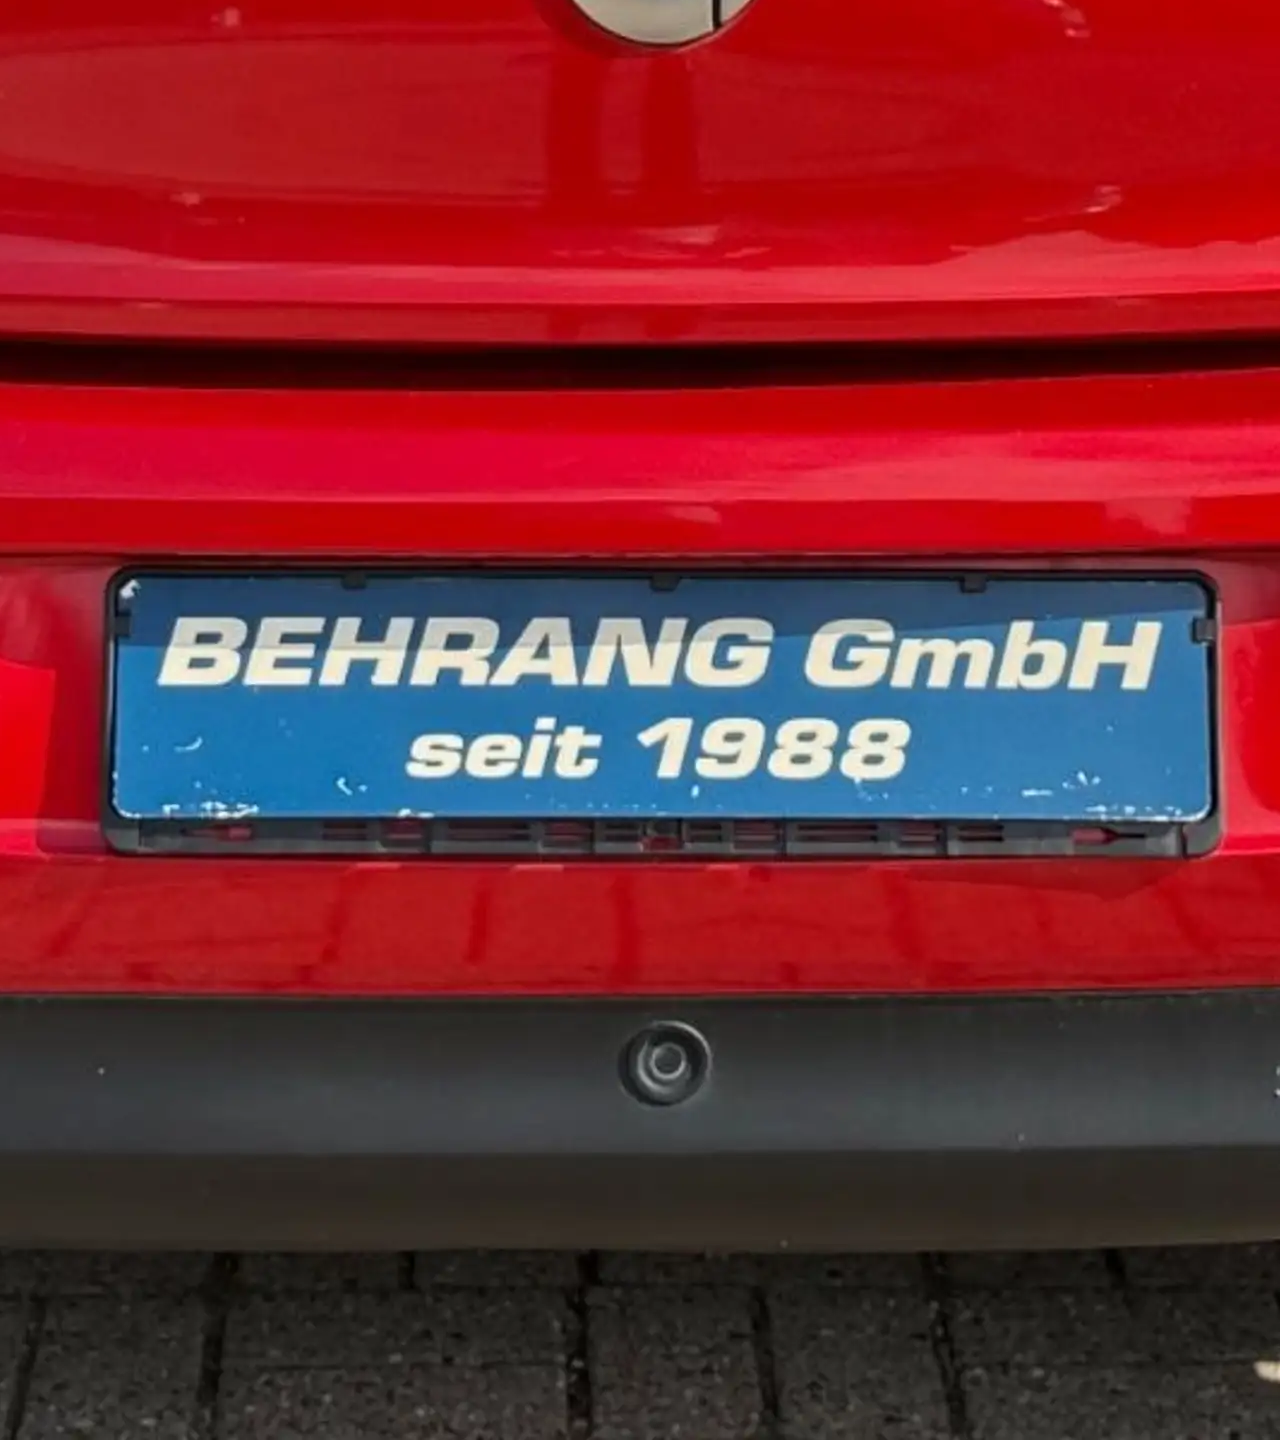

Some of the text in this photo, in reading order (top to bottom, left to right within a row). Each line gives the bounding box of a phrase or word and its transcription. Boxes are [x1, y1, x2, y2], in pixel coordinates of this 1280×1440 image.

[156, 615, 1163, 691] BEHRANG GmbH
[405, 716, 911, 781] seit 1988
